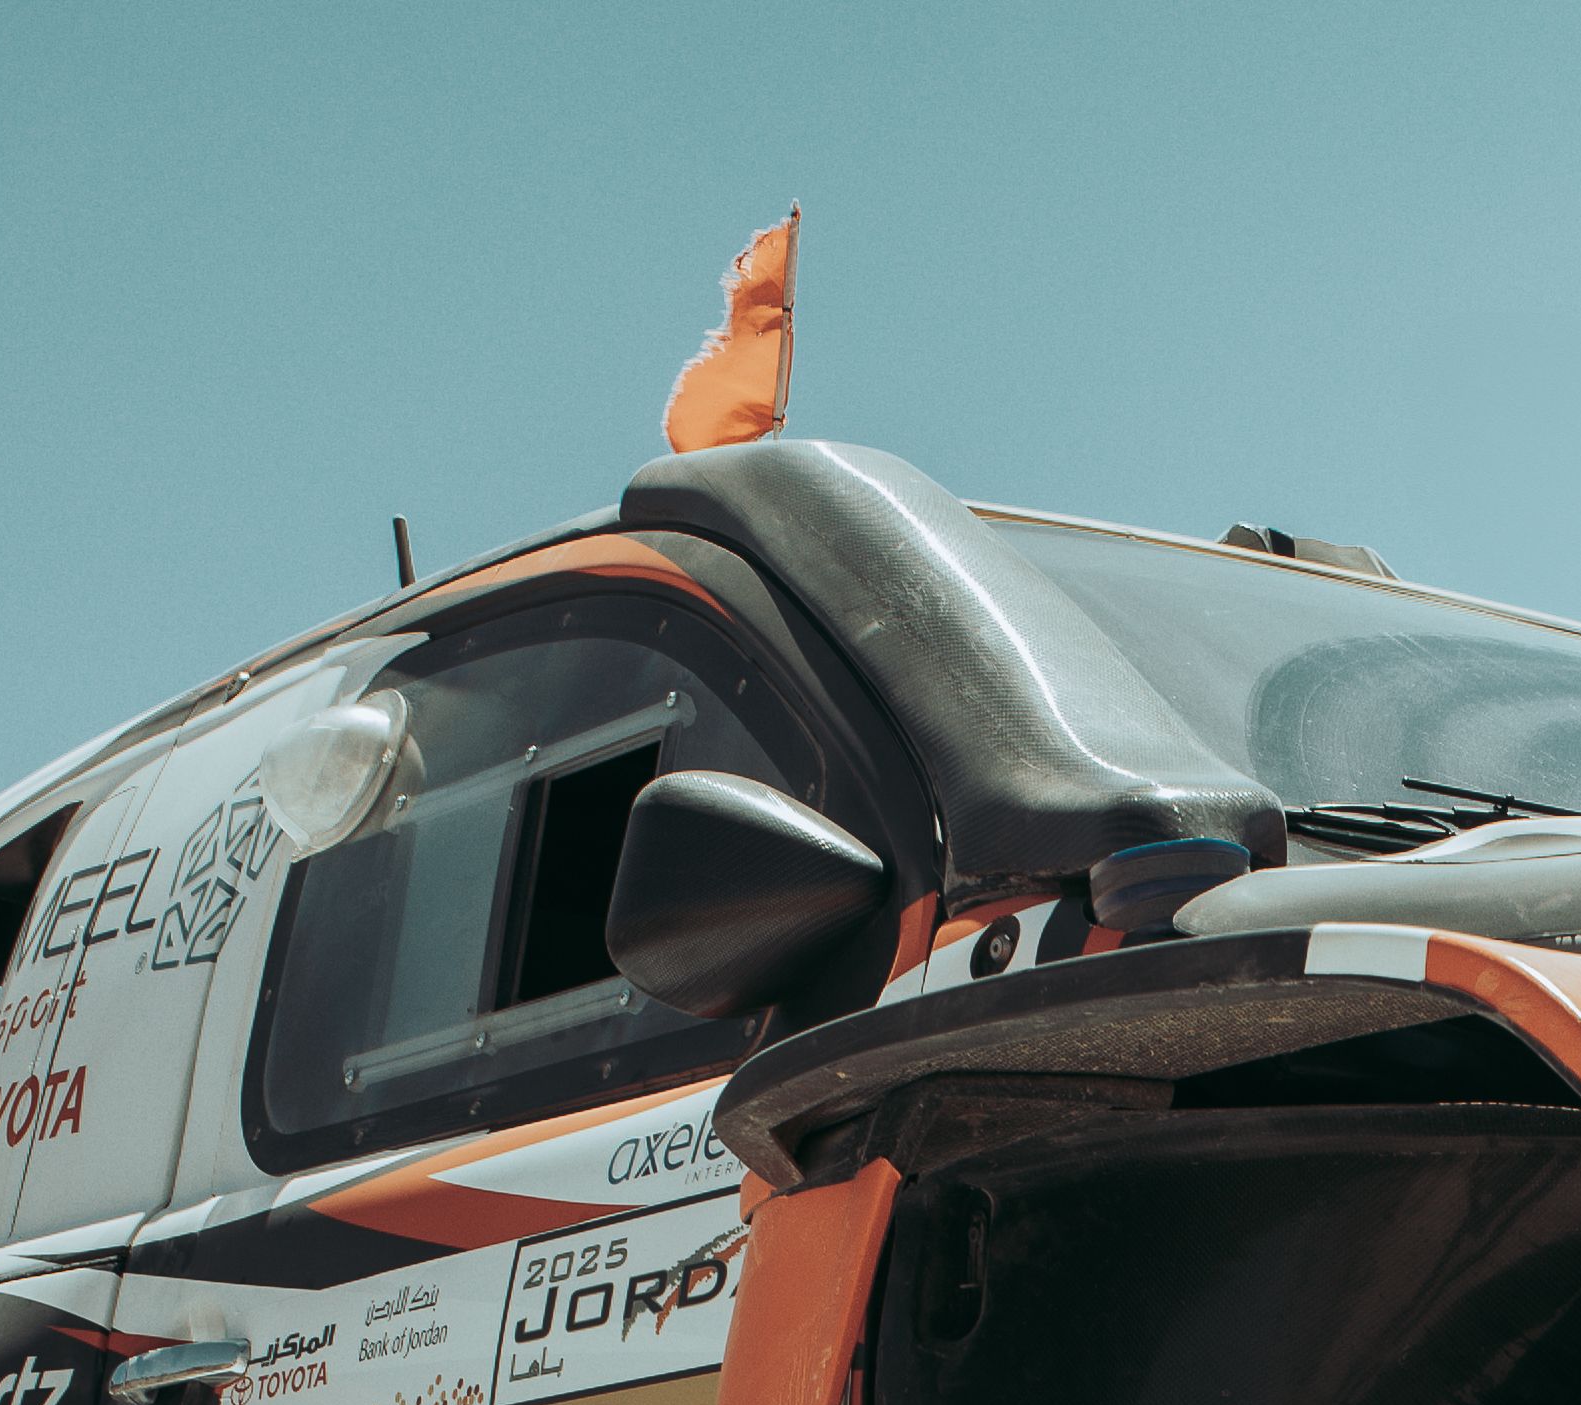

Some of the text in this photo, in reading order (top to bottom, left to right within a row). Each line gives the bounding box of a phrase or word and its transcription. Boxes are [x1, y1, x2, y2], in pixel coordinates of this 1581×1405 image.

[684, 1160, 744, 1185] INTERN
[522, 1237, 628, 1290] 2025
[514, 1259, 738, 1343] JORD
[359, 1320, 449, 1362] Bank of Jordan
[258, 1361, 327, 1400] TOYOTA
